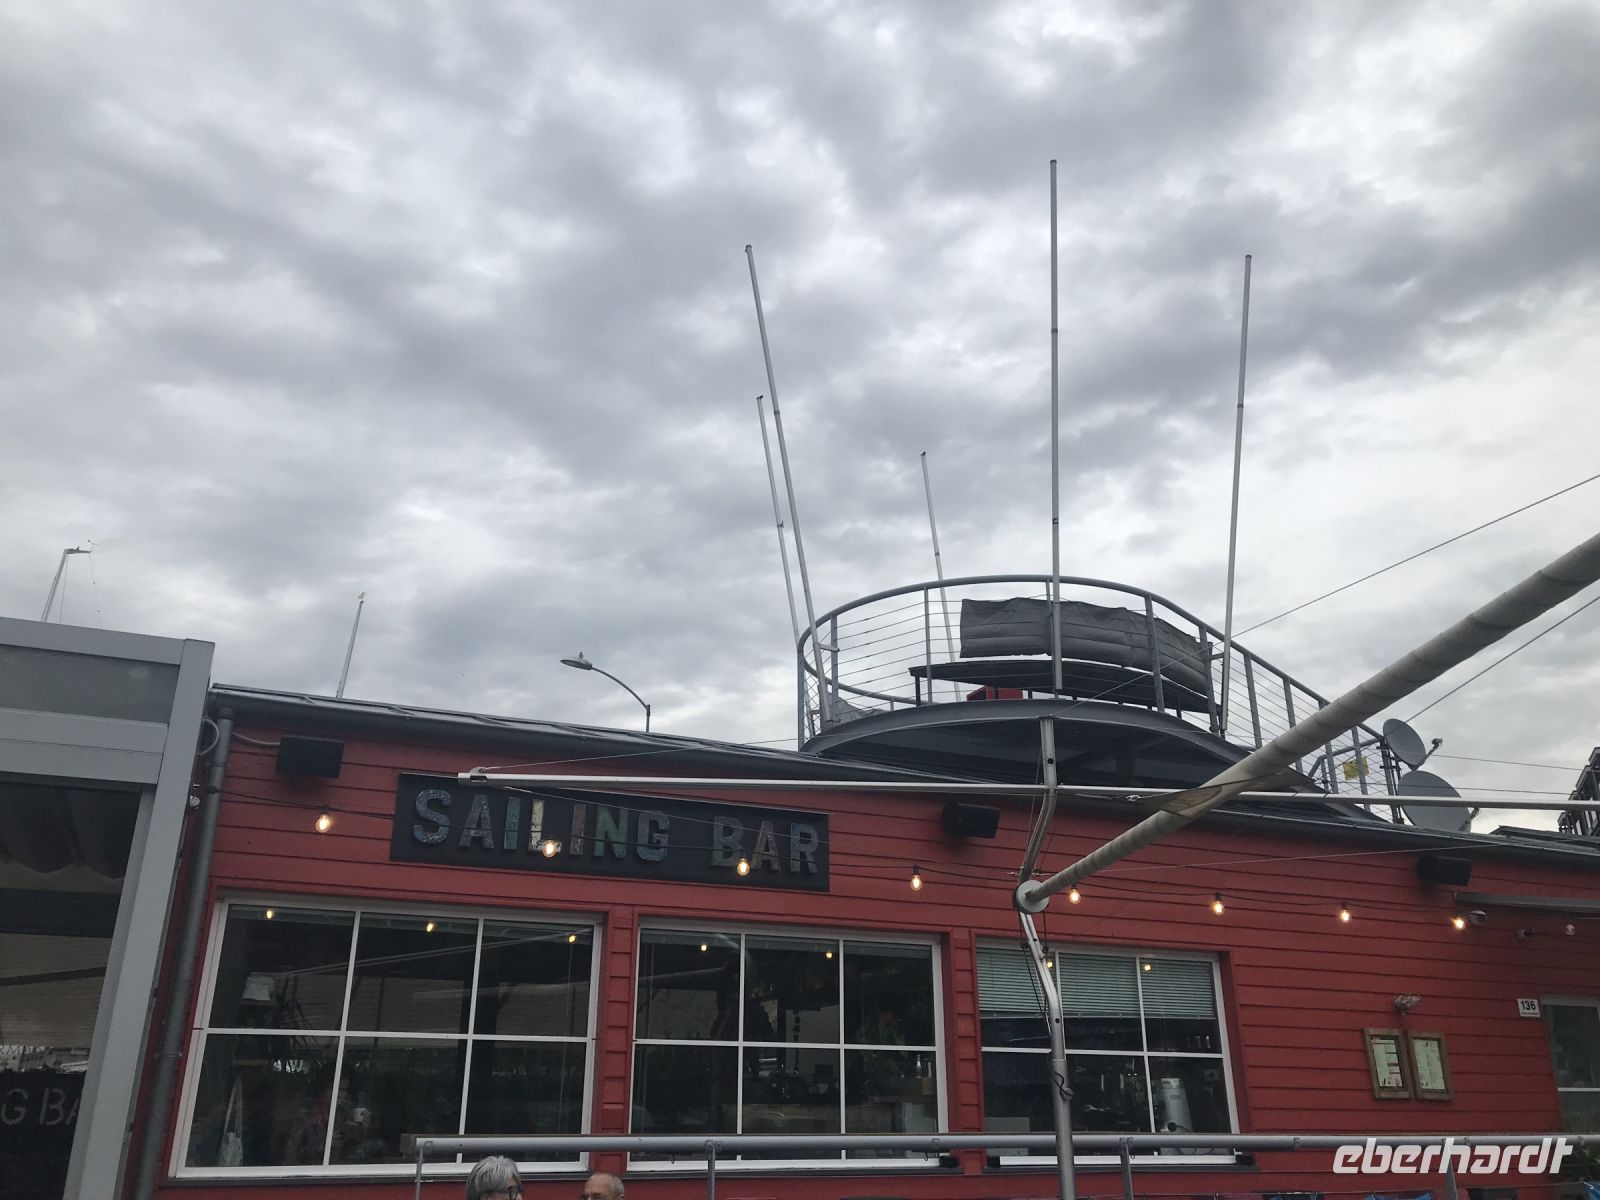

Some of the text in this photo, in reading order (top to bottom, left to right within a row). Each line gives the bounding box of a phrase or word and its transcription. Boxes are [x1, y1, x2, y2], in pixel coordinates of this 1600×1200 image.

[413, 789, 819, 875] SAILING BAR
[1521, 1000, 1536, 1011] 136
